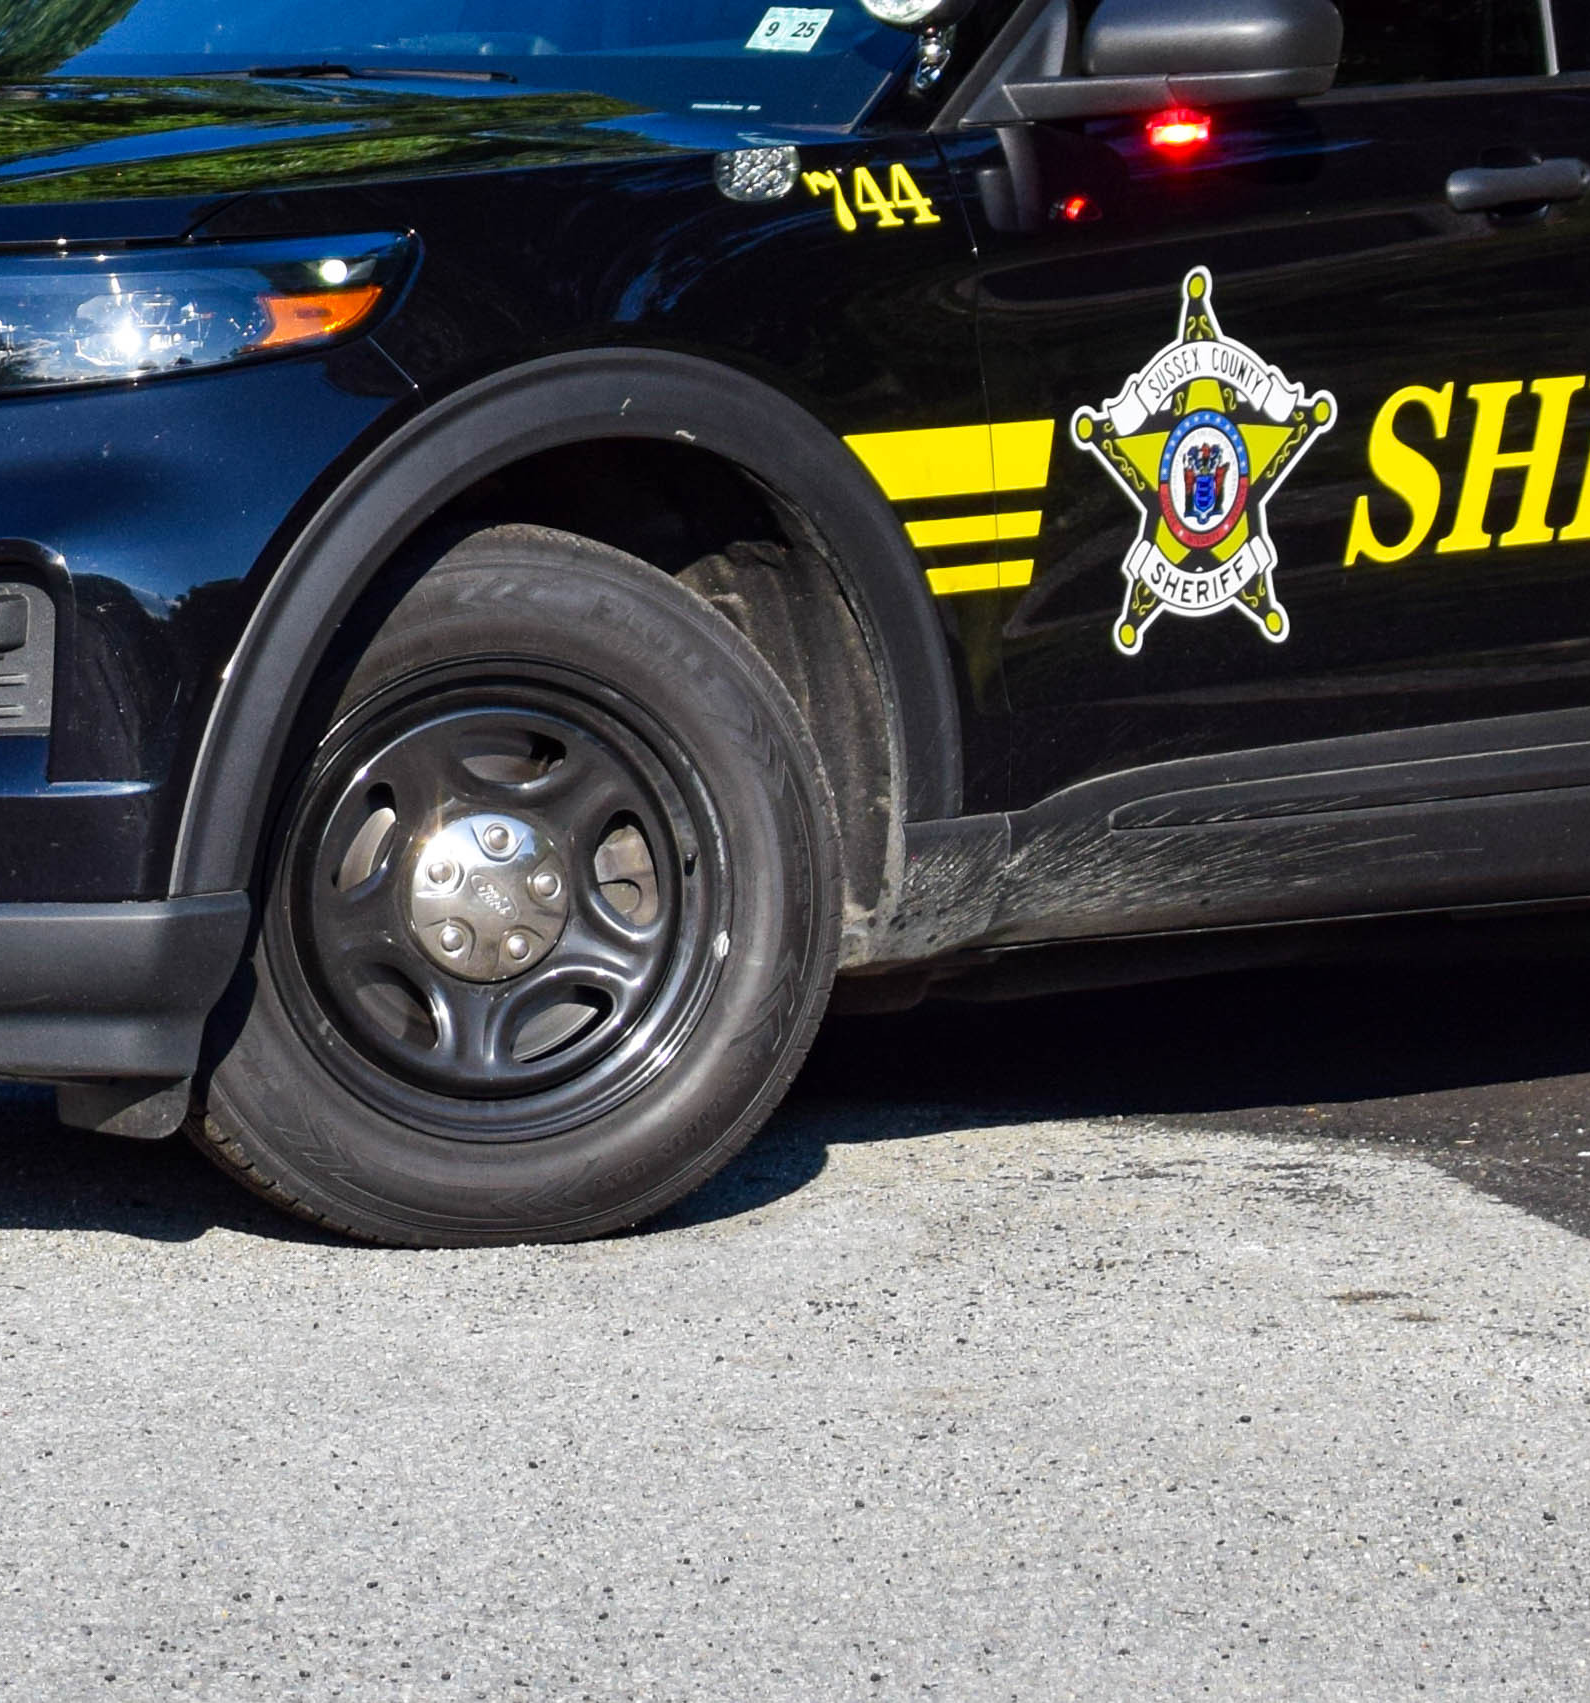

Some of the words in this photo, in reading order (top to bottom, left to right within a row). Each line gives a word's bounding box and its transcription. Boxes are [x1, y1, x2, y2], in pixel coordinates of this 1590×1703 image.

[765, 21, 780, 37] 9
[791, 21, 818, 38] 25
[802, 163, 940, 232] 744
[1148, 347, 1201, 399] SUSSEX
[1211, 347, 1264, 394] COUNTY
[1150, 556, 1246, 604] SHERIFF
